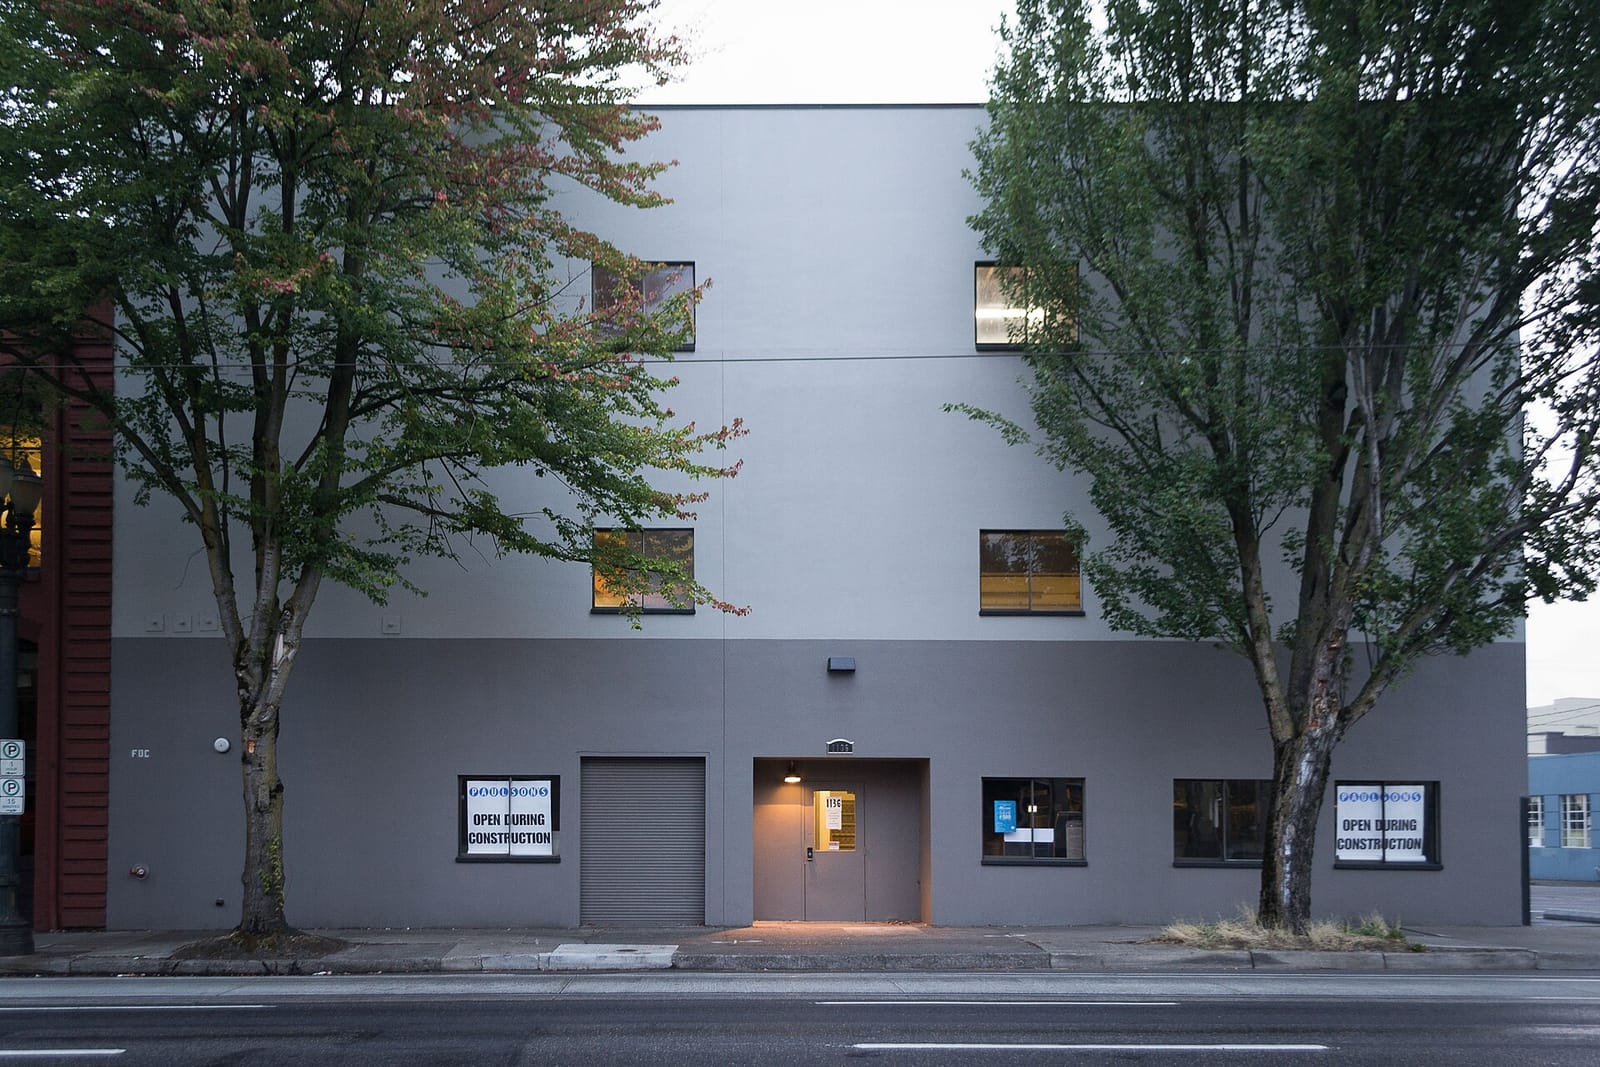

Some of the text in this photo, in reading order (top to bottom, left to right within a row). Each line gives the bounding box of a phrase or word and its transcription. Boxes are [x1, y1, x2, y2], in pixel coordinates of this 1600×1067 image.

[8, 745, 17, 755] P
[7, 782, 17, 793] P
[826, 798, 841, 808] 1136
[473, 813, 545, 826] OPEN DURING
[1343, 819, 1417, 831] OPEN DURING
[468, 832, 551, 845] CONSTRUCTION
